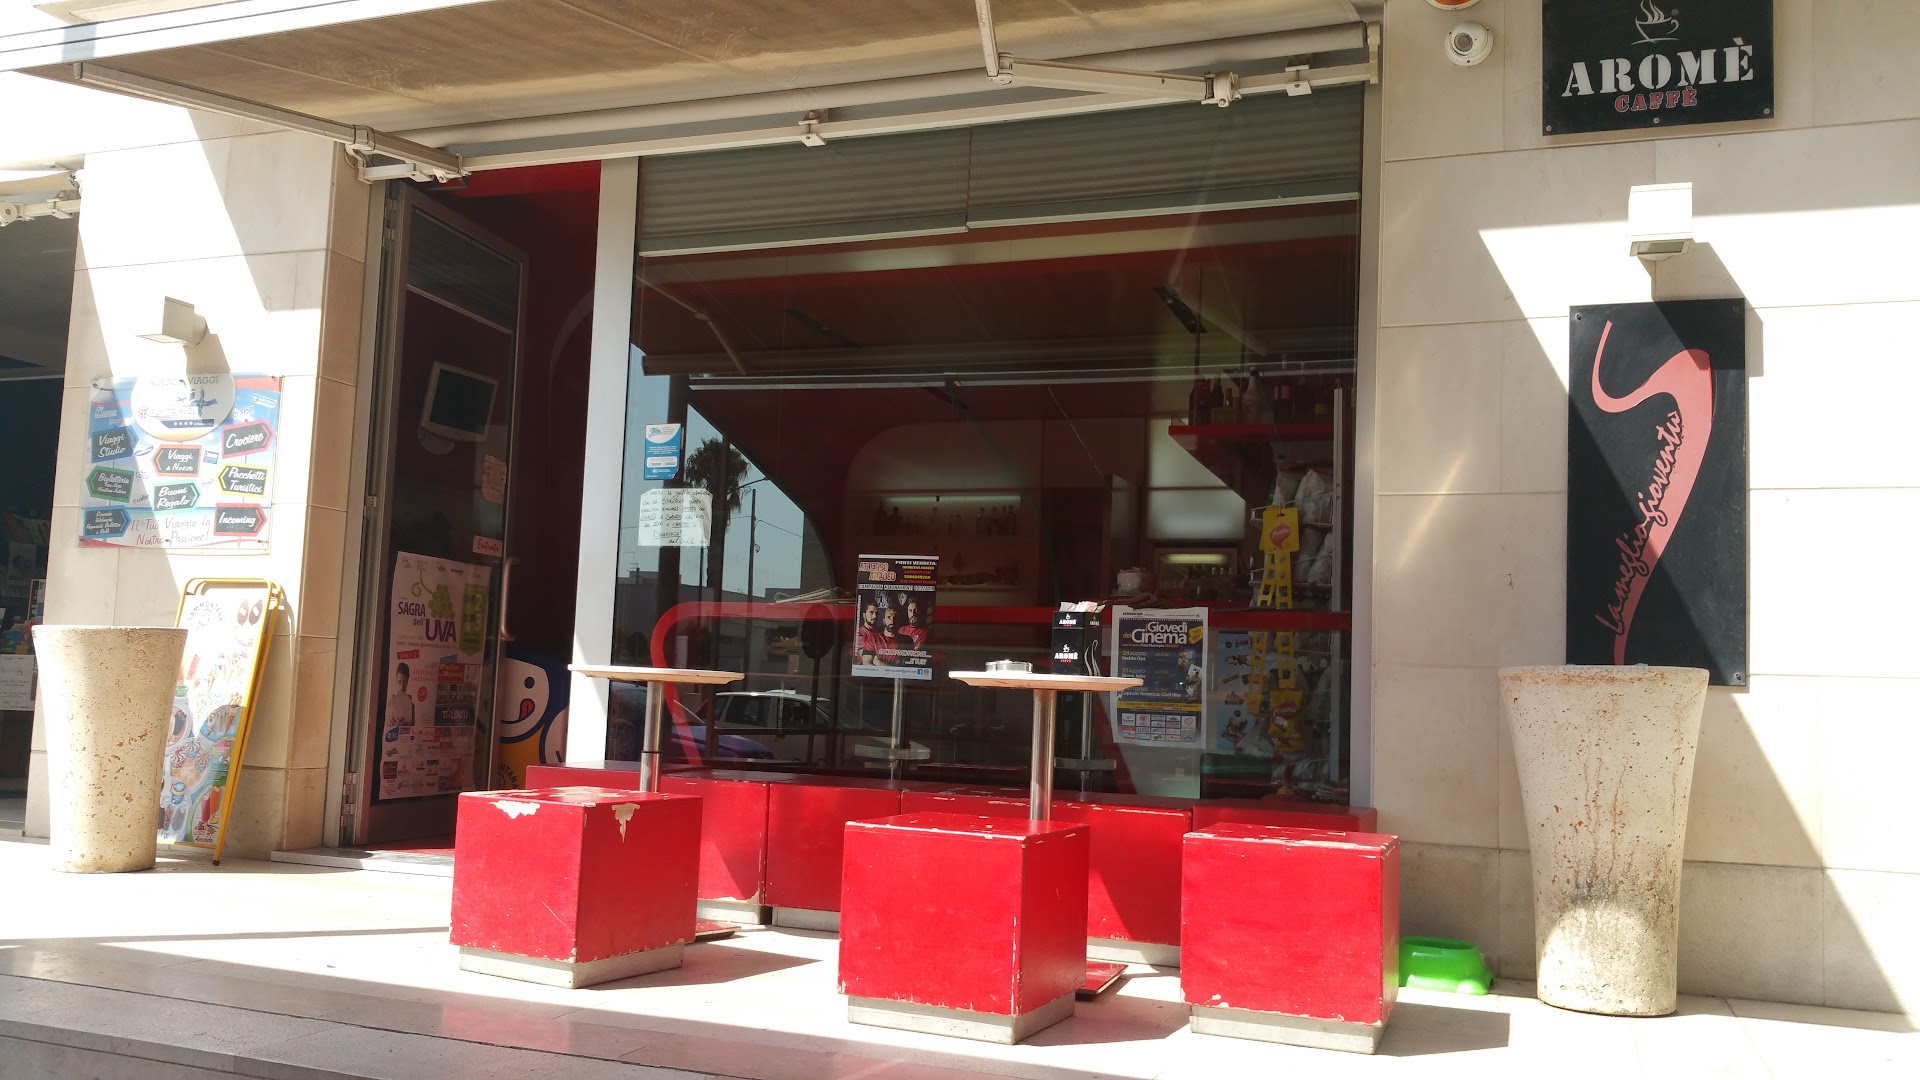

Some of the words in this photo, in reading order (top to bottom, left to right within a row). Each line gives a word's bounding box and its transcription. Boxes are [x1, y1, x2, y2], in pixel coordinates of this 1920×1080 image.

[1562, 37, 1754, 97] AROMÈ
[1615, 86, 1697, 112] CAFFÈ
[188, 376, 218, 384] VIAGGI
[99, 433, 125, 446] Viaggi
[226, 433, 264, 448] Crociere
[98, 445, 126, 458] Studio
[168, 450, 193, 462] Viaggi
[228, 467, 265, 480] Pacchetti
[159, 487, 187, 496] Buoni
[230, 480, 262, 492] Turistici
[157, 496, 190, 509] Regalo
[145, 519, 159, 530] Tuo
[165, 516, 197, 529] Viaggio
[219, 512, 256, 527] Incoming
[136, 533, 164, 545] Nostra
[478, 539, 500, 551] Entrata
[398, 602, 426, 617] SAGRA
[425, 618, 457, 642] UVA
[1148, 621, 1187, 633] Giovedì
[1132, 629, 1187, 644] Cinema
